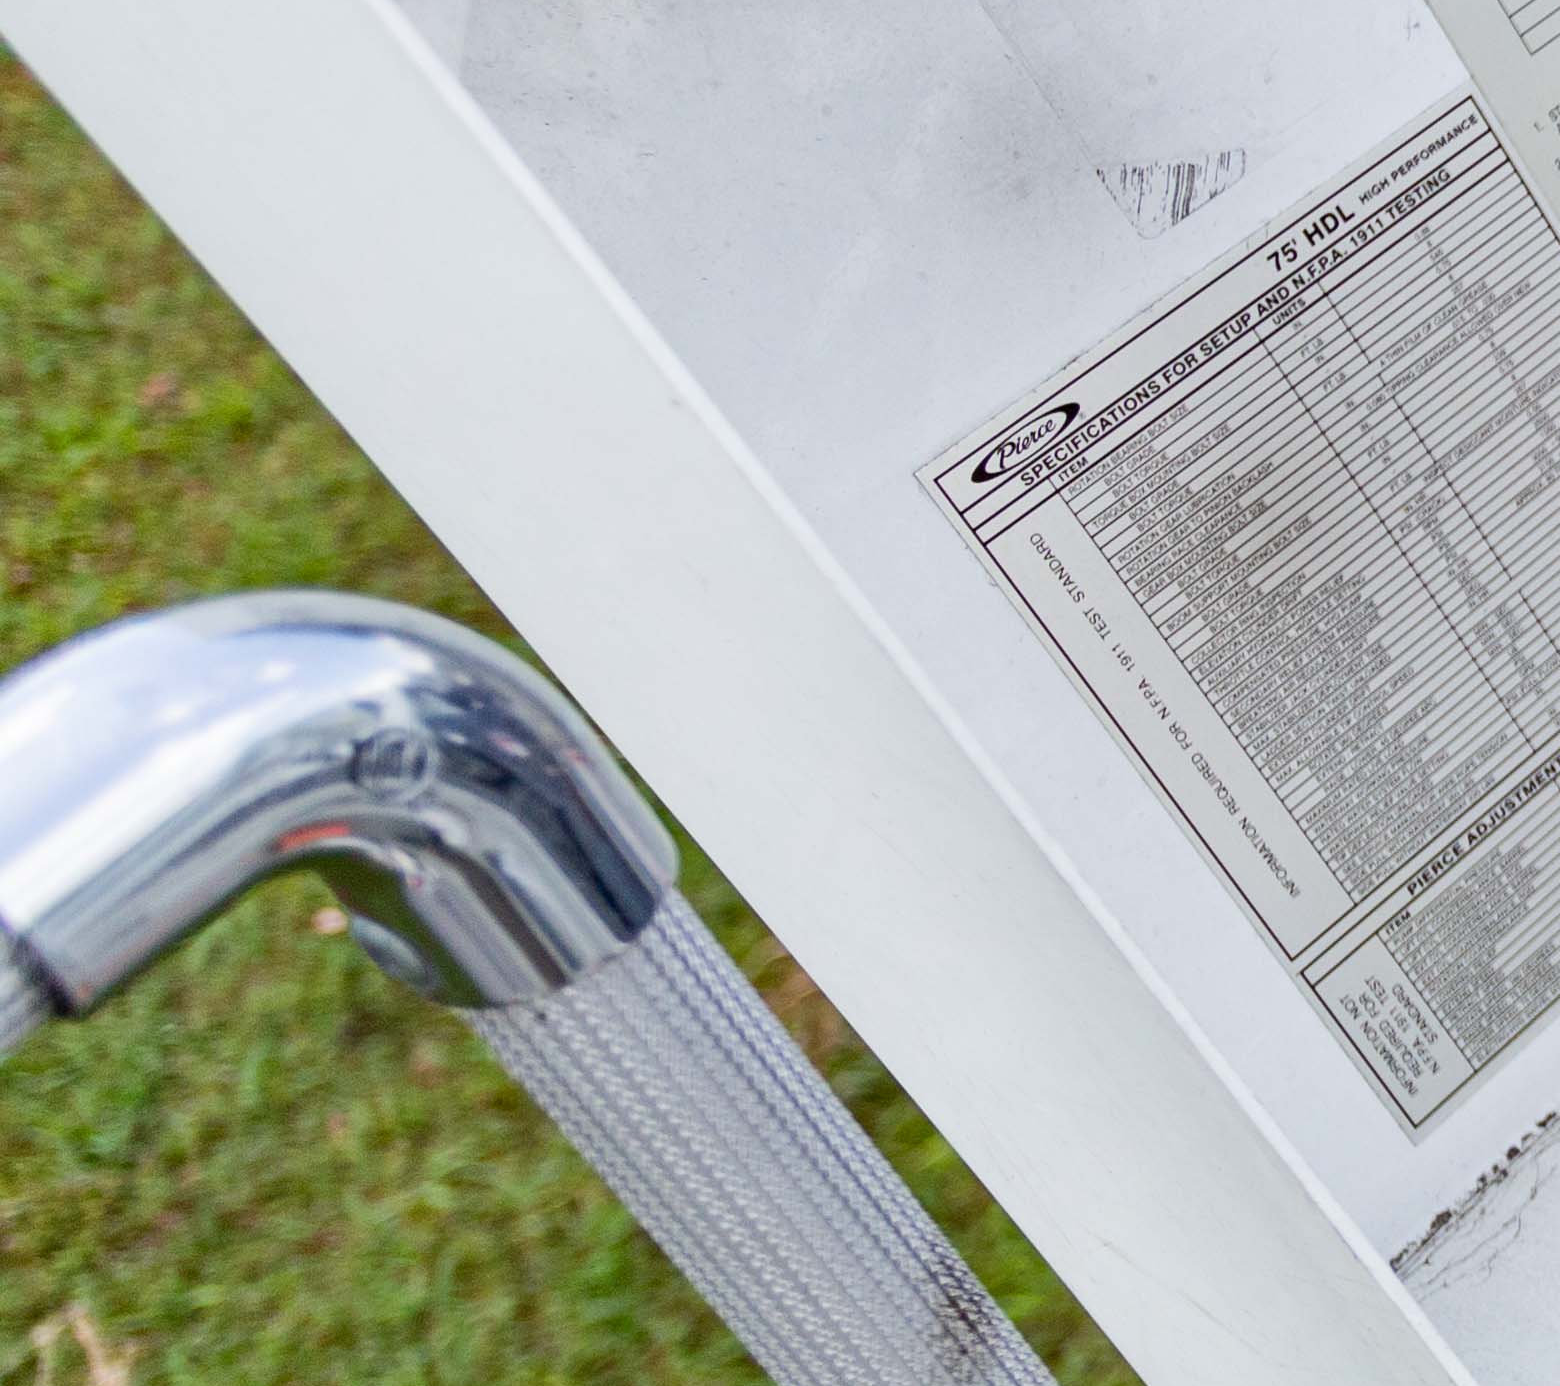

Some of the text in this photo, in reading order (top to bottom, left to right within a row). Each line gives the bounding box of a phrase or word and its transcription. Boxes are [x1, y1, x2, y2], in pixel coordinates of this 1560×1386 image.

[1265, 113, 1477, 272] 75' HDL HIGH PERFORMANCE
[1015, 380, 1165, 486] SPECIFICATIONS
[1158, 352, 1202, 384] FOR
[1195, 312, 1258, 358] SETUP
[1251, 285, 1293, 317] AND
[1345, 217, 1388, 247] 1911
[1382, 168, 1455, 219] TESTING
[1053, 297, 1310, 482] ITEM UNITS
[996, 414, 1059, 470] Pierce
[1029, 532, 1085, 603] STANDARD
[1082, 606, 1111, 641] TEST
[1110, 642, 1135, 672] 1911
[1167, 720, 1192, 750] FOR
[1190, 752, 1240, 816] REQUIRED
[1239, 817, 1300, 897] INFORMATION
[1406, 838, 1464, 900] PIERCE
